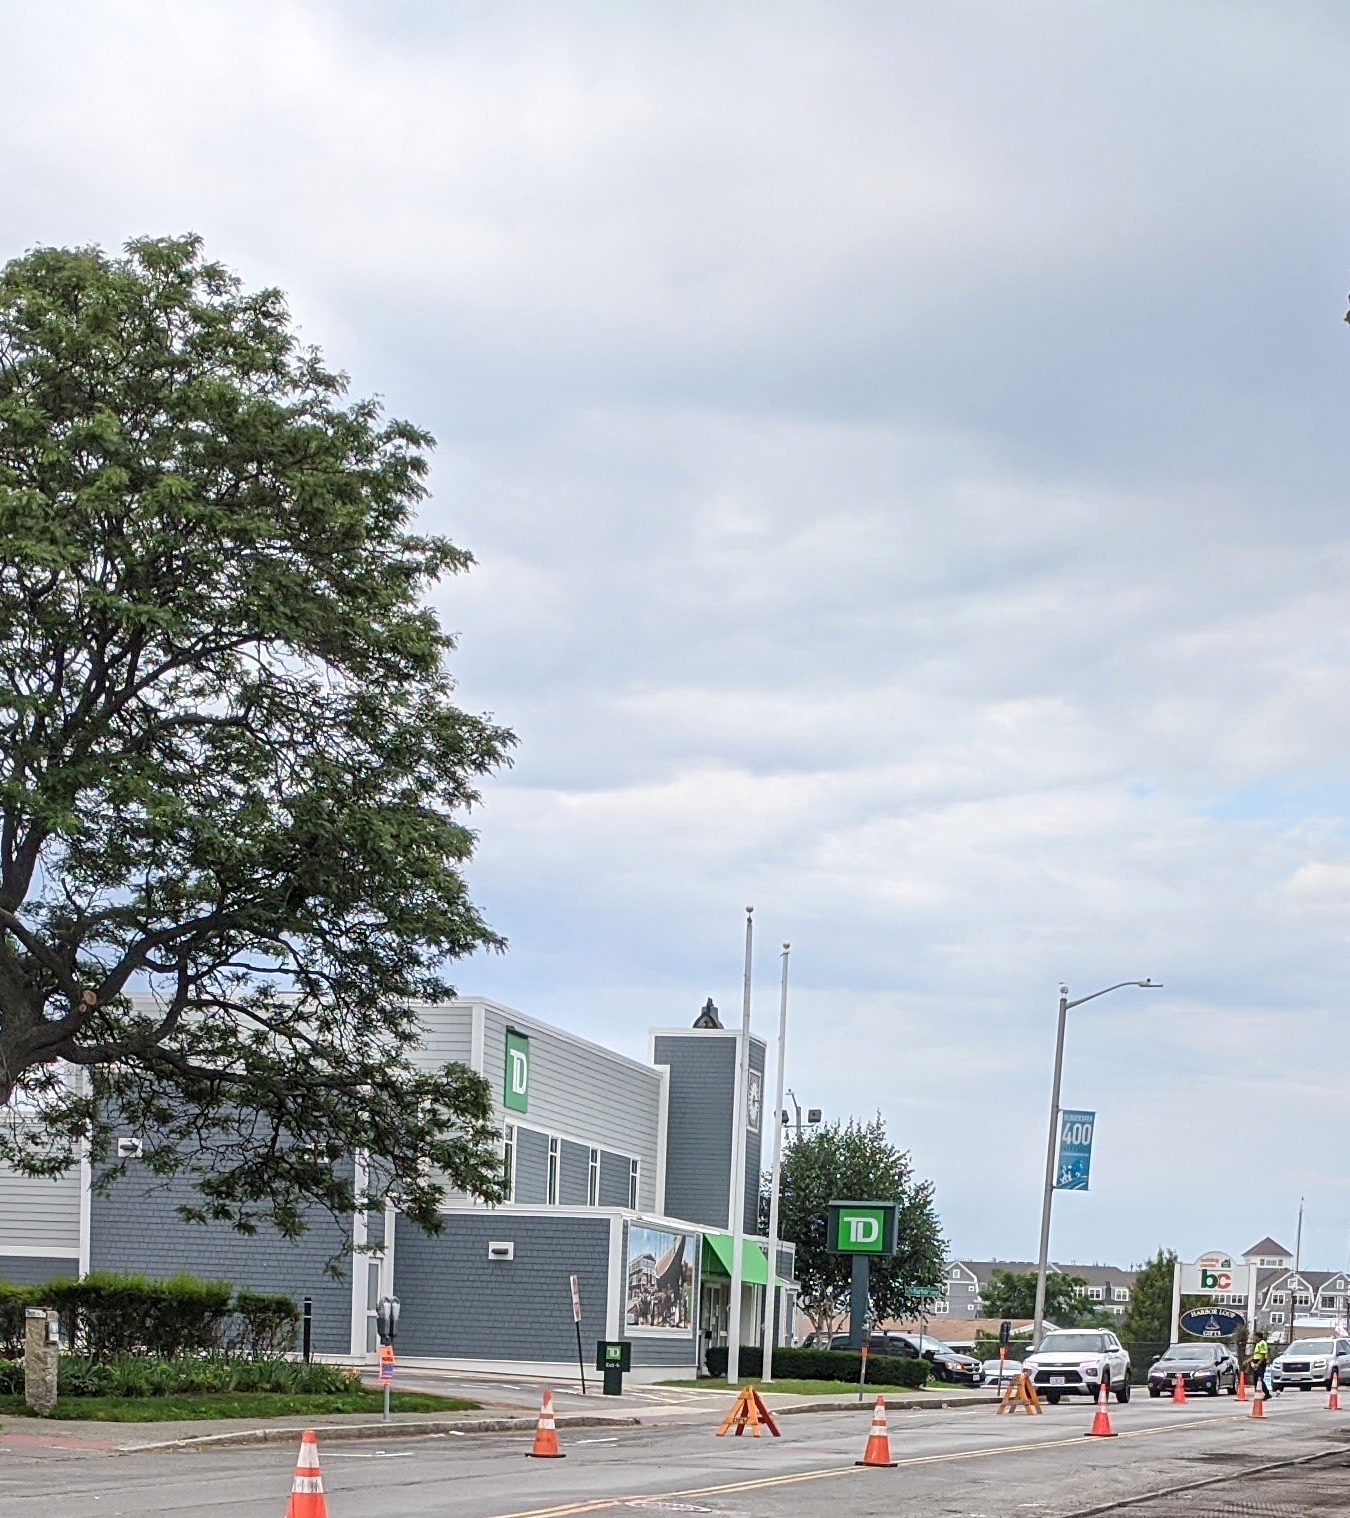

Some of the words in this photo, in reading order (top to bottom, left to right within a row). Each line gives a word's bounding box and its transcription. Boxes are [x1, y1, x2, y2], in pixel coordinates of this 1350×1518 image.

[509, 1048, 528, 1095] TD
[1062, 1122, 1092, 1146] 400
[843, 1216, 879, 1243] TD
[1200, 1268, 1231, 1289] bc
[607, 1347, 620, 1357] TD
